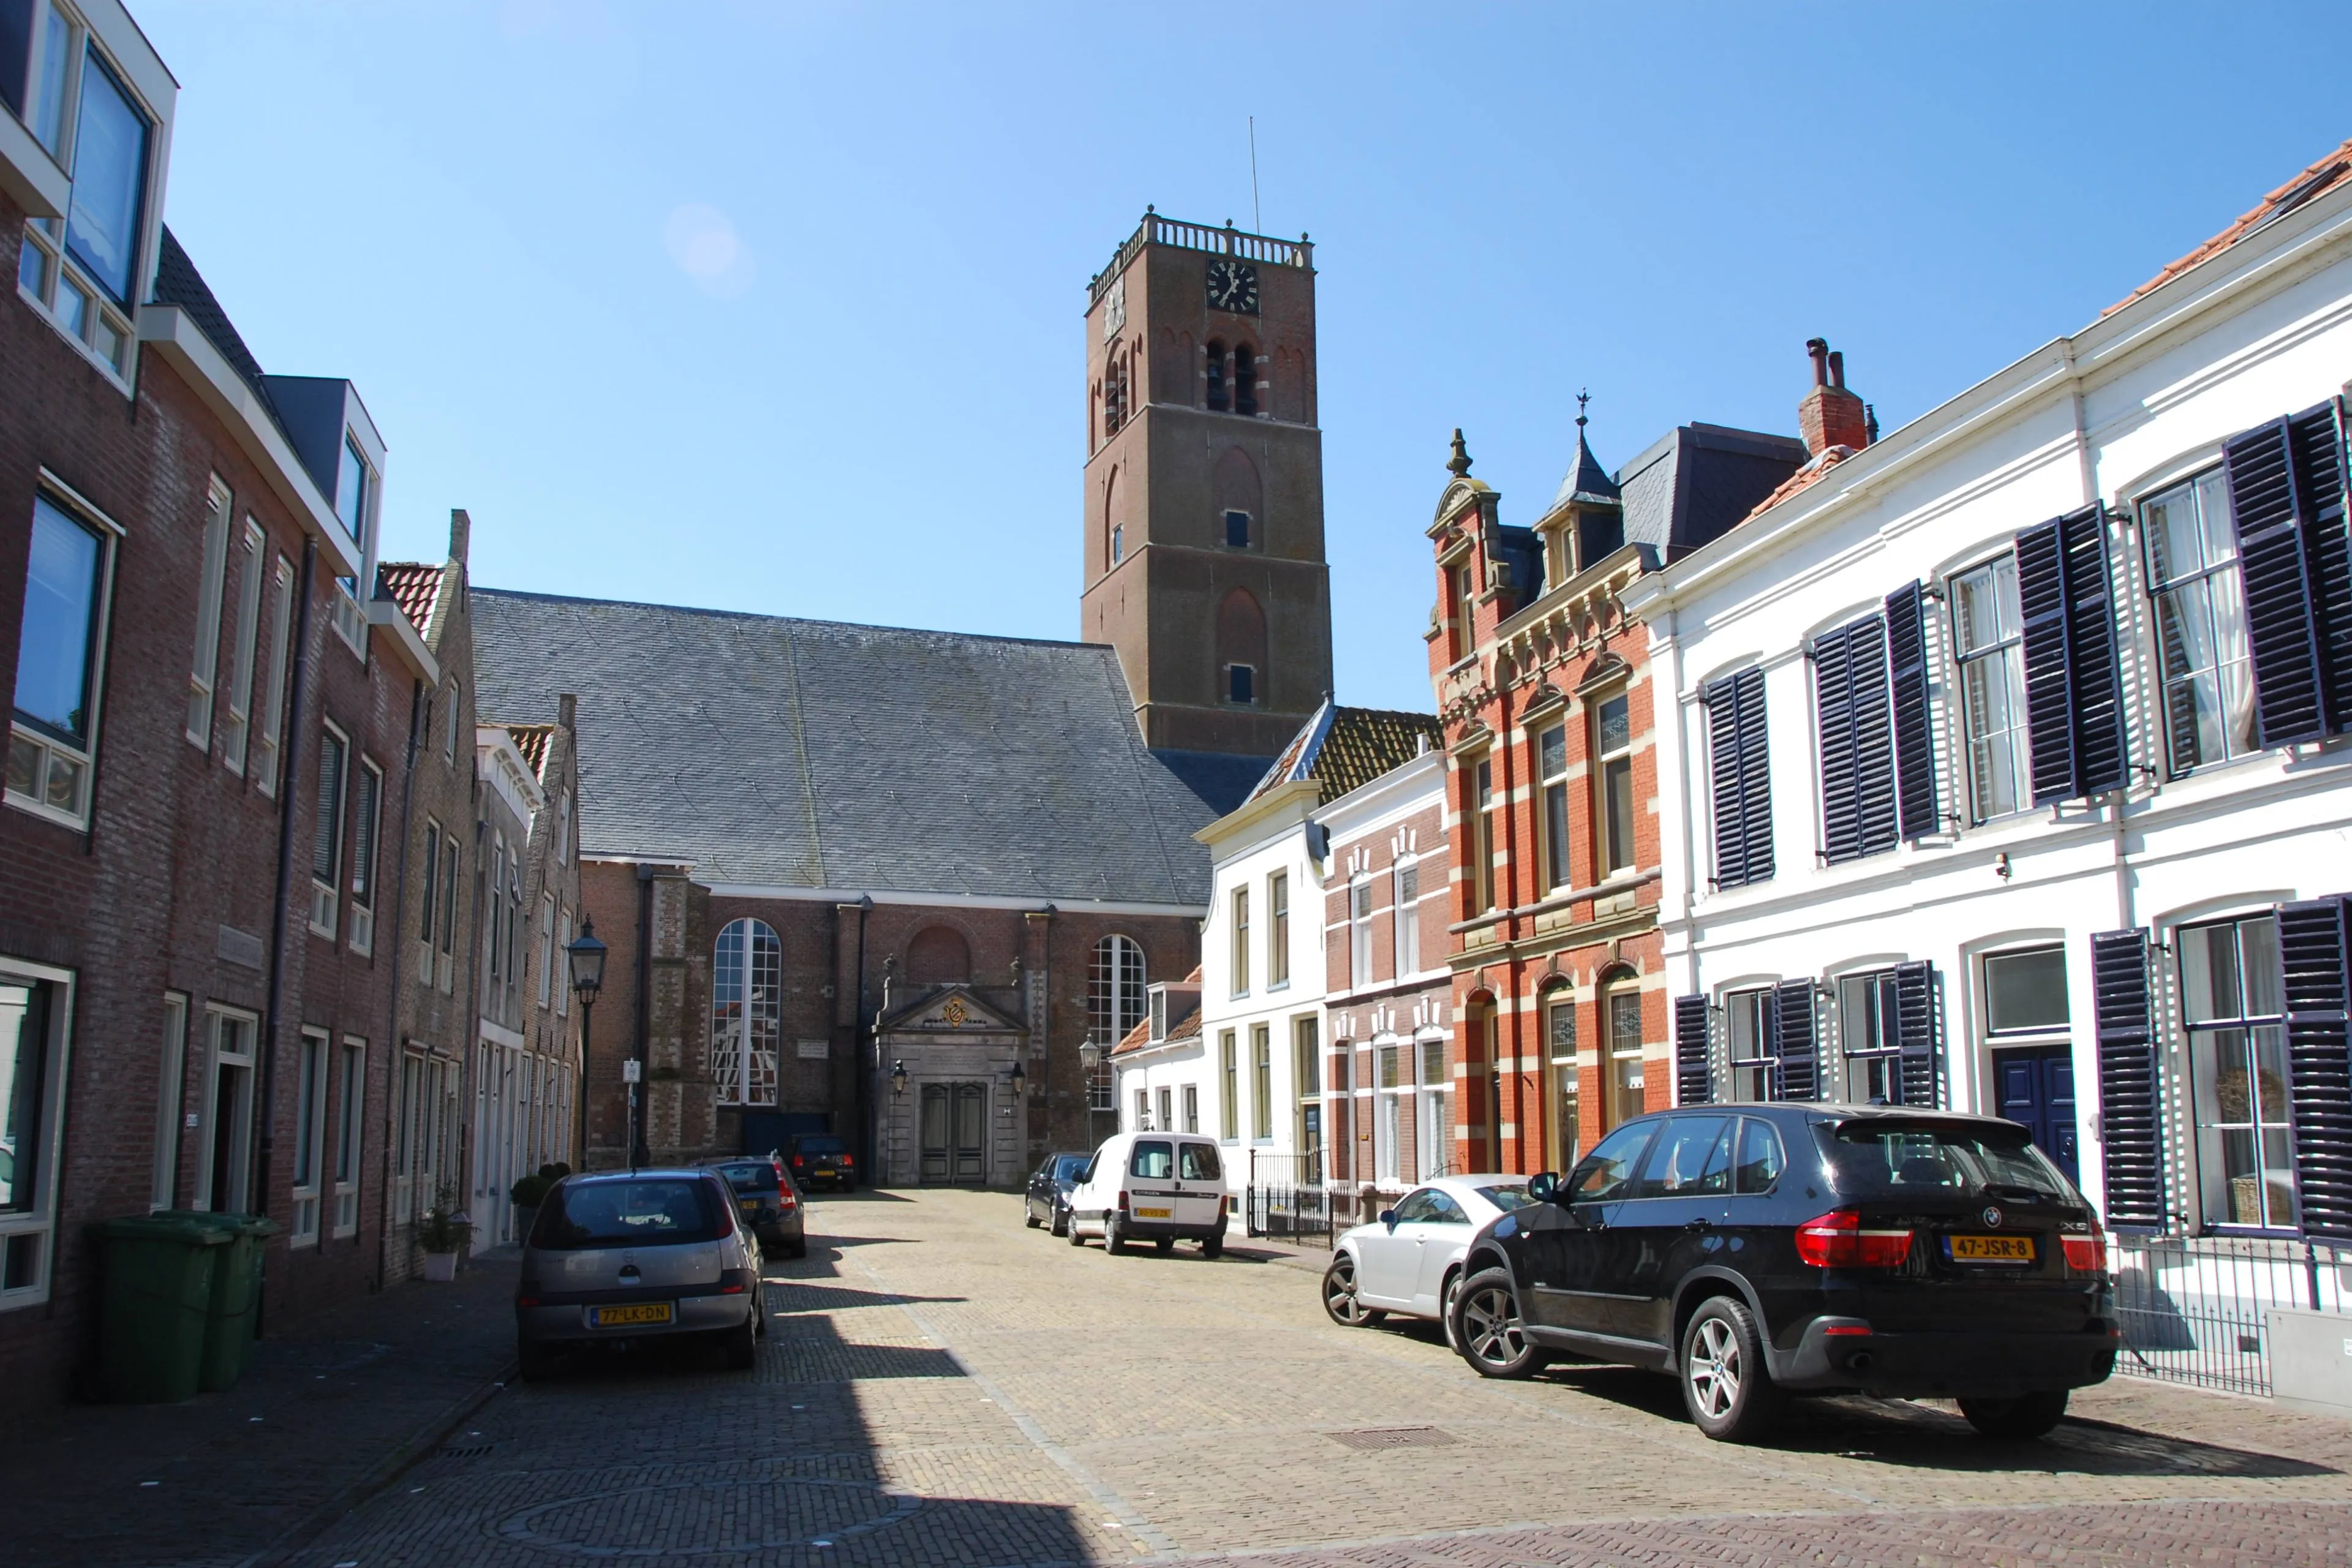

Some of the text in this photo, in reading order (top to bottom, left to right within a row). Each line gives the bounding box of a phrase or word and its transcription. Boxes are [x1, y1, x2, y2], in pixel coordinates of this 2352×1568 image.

[2062, 1222, 2088, 1231] X5
[1957, 1238, 2027, 1256] 47-JSR-8
[603, 1307, 665, 1321] 77-LK-DN
